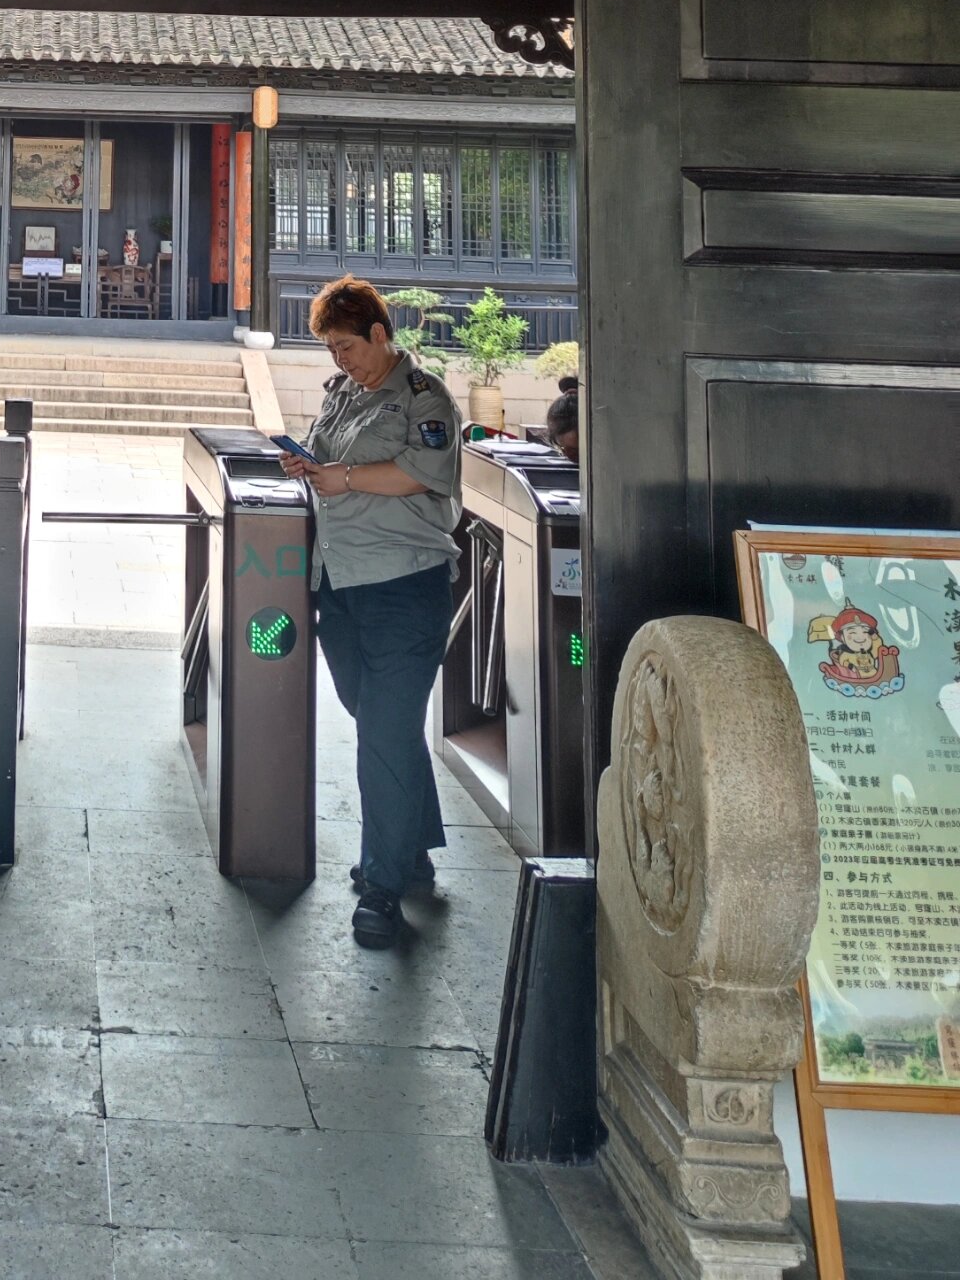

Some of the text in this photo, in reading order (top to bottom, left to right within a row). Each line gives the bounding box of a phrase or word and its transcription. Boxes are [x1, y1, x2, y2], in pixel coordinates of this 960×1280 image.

[235, 542, 307, 579] 入口
[809, 742, 876, 754] 二、针对人群
[823, 870, 893, 884] 四、参与方式
